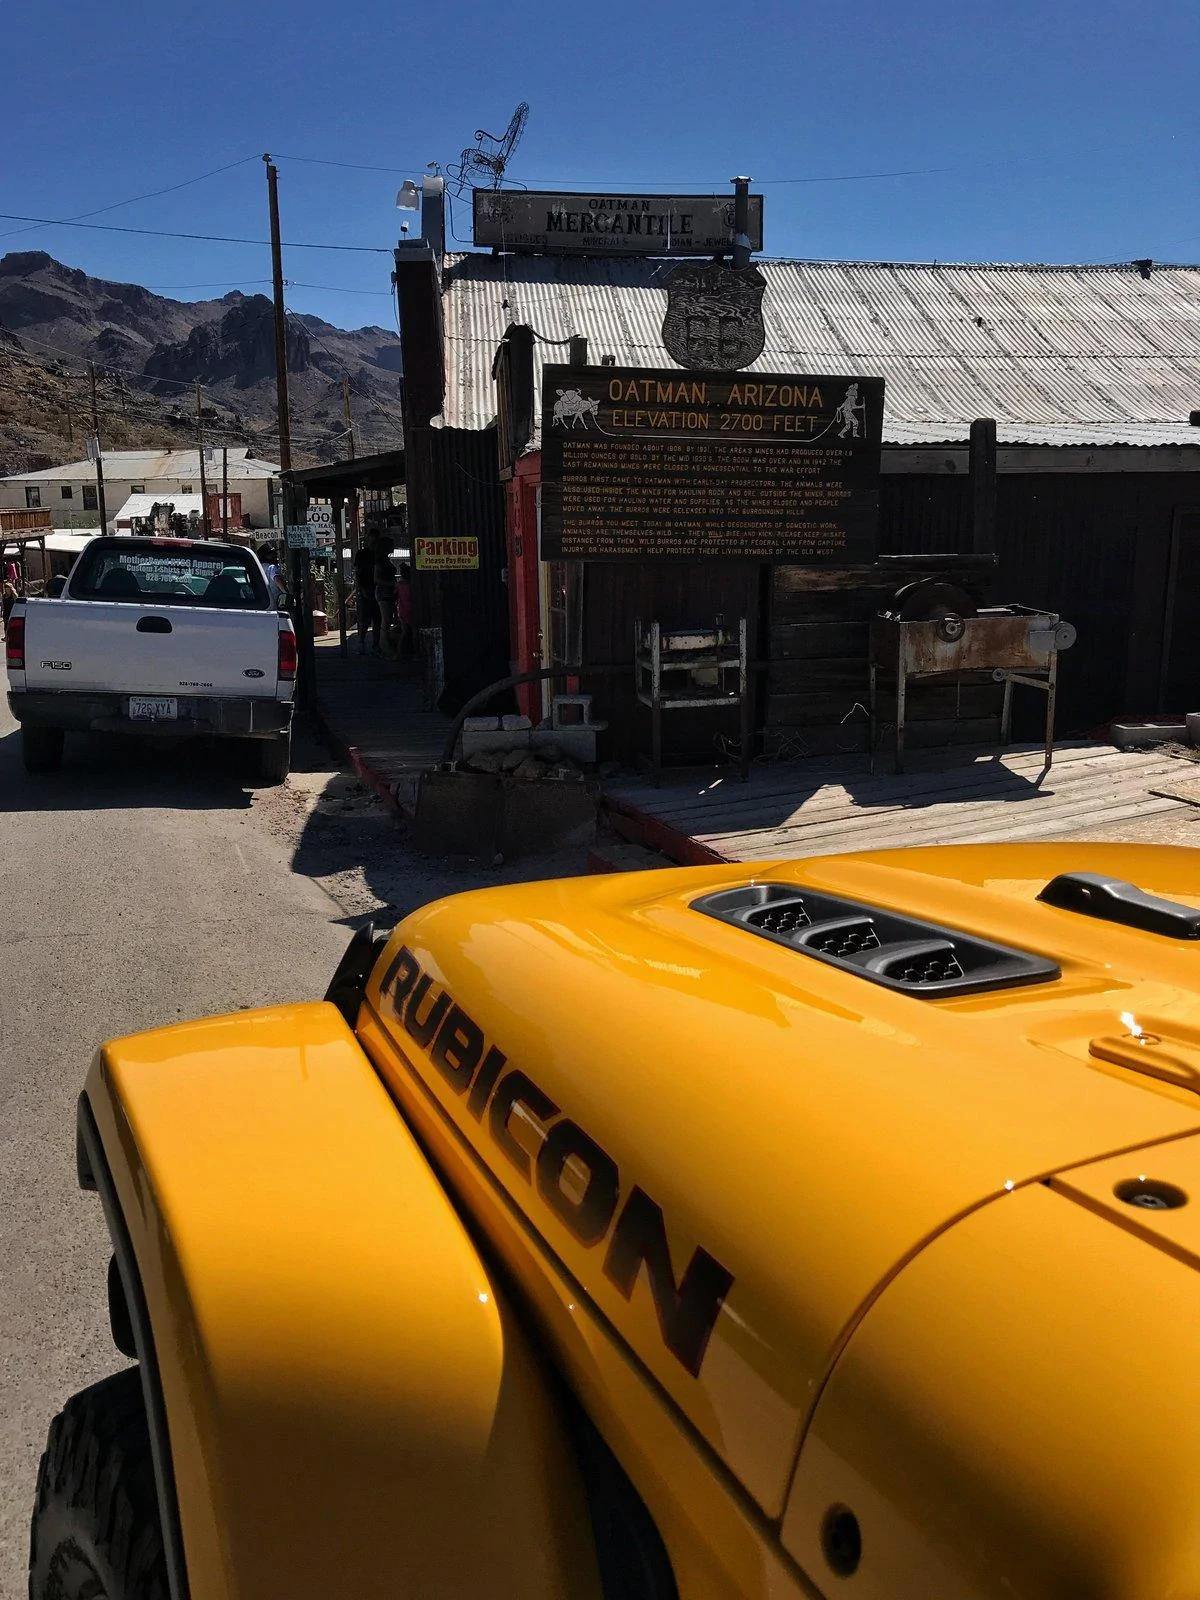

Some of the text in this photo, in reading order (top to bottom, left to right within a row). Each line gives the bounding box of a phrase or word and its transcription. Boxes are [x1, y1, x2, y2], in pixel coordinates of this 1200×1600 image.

[588, 198, 650, 211] OATMAN
[546, 211, 694, 235] MERCANTILE
[727, 383, 824, 408] ARIZONA
[612, 409, 818, 432] ELEVATION 2700 FEET
[255, 531, 279, 540] Beacon
[416, 539, 478, 557] Parking
[192, 559, 224, 570] Apparel
[446, 557, 457, 565] Pay
[126, 564, 153, 572] Custom
[154, 566, 180, 574] T-Shirts
[379, 945, 736, 1379] RUBICON
